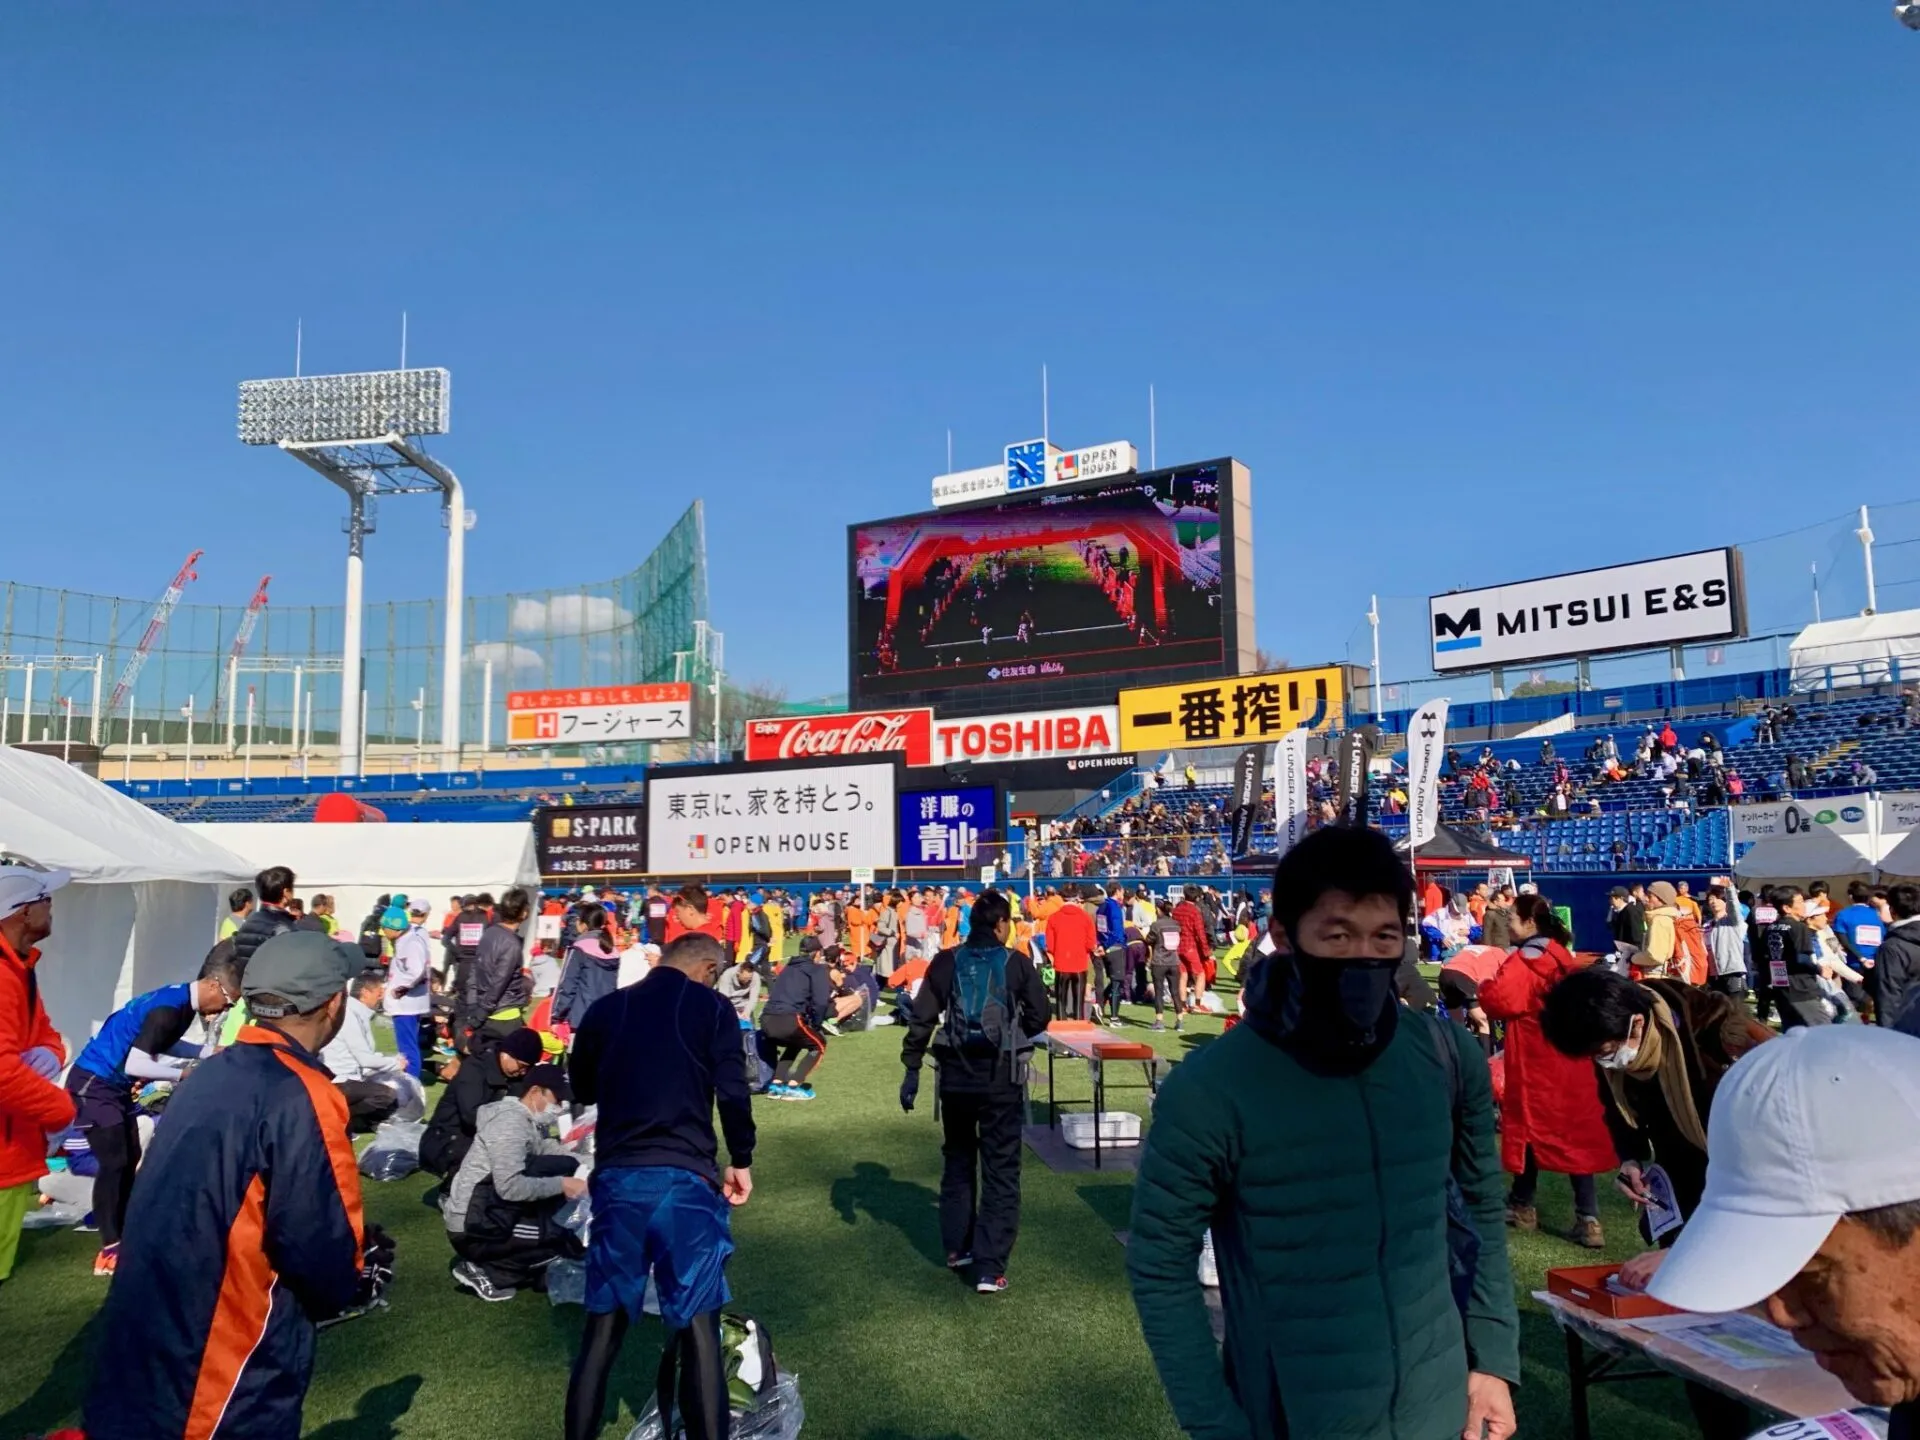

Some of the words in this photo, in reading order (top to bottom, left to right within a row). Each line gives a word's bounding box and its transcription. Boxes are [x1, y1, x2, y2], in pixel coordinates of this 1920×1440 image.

[1082, 449, 1117, 464] OPEN
[1082, 461, 1117, 475] HOUSE
[1497, 593, 1630, 636] MITSUI
[1644, 579, 1727, 616] E&S
[562, 709, 685, 734] フージャース
[1133, 679, 1328, 741] 一番搾り
[754, 722, 783, 736] Enjoy
[778, 714, 912, 759] Coca-Cola
[938, 715, 1111, 758] TOSHIBA
[1078, 758, 1103, 768] OPEN
[1104, 756, 1134, 767] HOUSE
[1287, 754, 1295, 795] UNDER
[1350, 750, 1361, 793] UNDER
[1421, 743, 1432, 784] UNDER
[667, 783, 874, 820] 東京に、家を持とう。
[1242, 768, 1254, 805] UNDER
[920, 795, 975, 819] 洋服の
[1415, 787, 1425, 838] ARMOUR
[572, 815, 637, 837] S-PARK
[715, 835, 770, 854] OPEN
[779, 832, 849, 852] HOUSE
[918, 821, 978, 861] 青山
